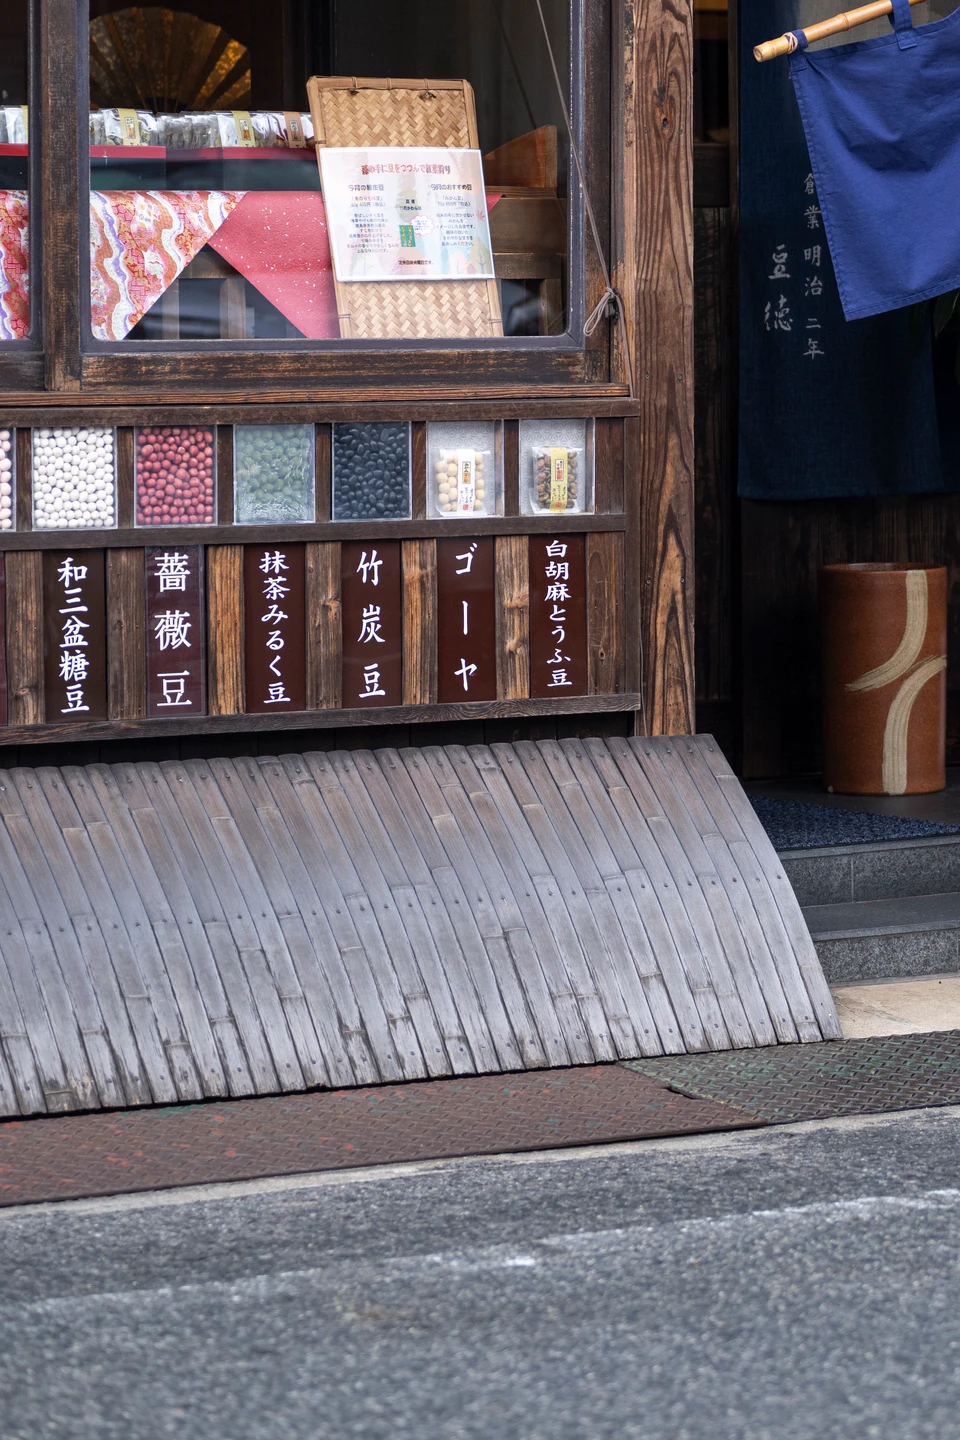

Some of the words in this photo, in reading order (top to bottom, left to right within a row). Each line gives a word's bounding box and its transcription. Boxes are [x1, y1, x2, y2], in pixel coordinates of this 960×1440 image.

[764, 244, 793, 331] 豆徳
[57, 557, 90, 714] 和三盆糖豆
[153, 552, 193, 707] 薔薇豆
[258, 550, 291, 704] 抹茶みるく豆
[356, 550, 386, 699] 竹炭豆
[454, 543, 478, 692] ゴーヤ
[544, 539, 573, 687] 白胡麻とうふ豆
